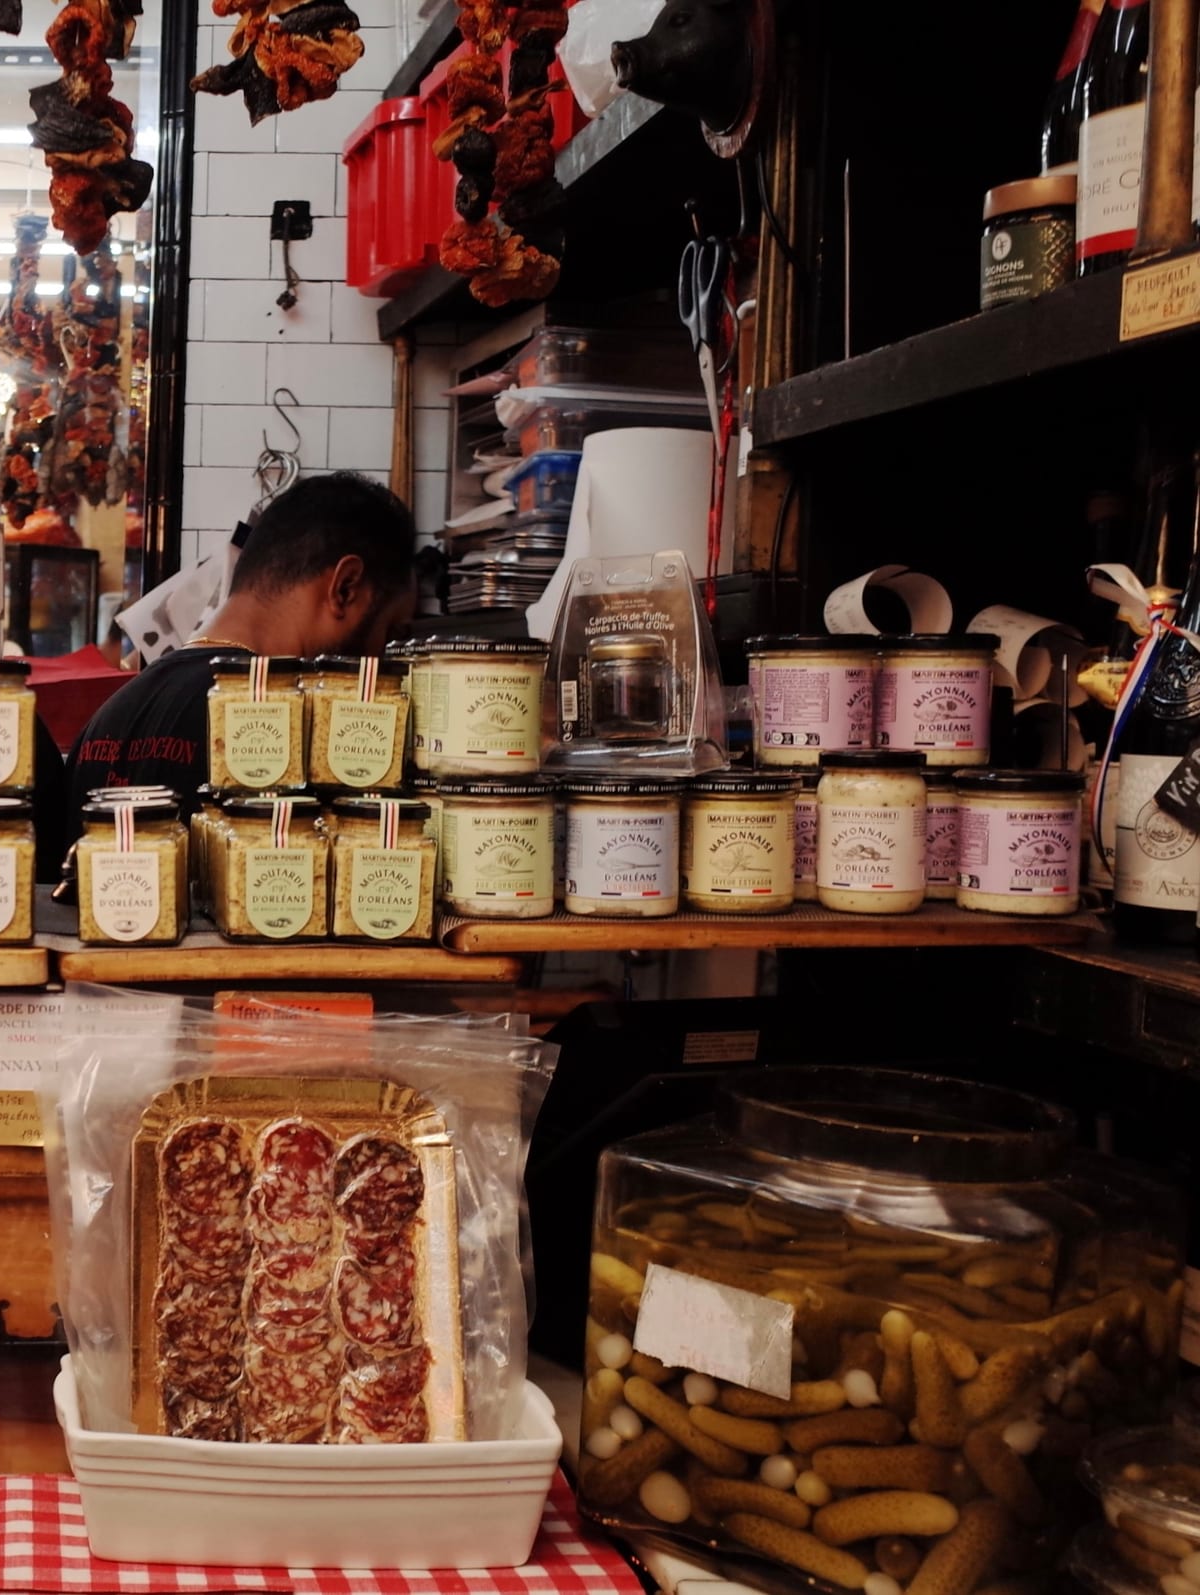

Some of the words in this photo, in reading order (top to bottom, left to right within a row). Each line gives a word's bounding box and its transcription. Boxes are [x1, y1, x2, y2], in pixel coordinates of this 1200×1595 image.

[589, 613, 628, 626] Carpaccio
[467, 692, 528, 716] MAYONNAISE
[913, 686, 976, 708] MAYONNAISE
[232, 721, 282, 740] MOUTARDE
[336, 721, 387, 742] MOUTARDE
[475, 834, 536, 856] MAYONNAISE
[599, 833, 662, 855] MAYONNAISE
[709, 831, 773, 854] MAYONNAISE
[832, 826, 896, 849] MAYONNAISE
[253, 868, 305, 888] MOUTARDE
[360, 869, 412, 891] MOUTARDE
[252, 894, 306, 903] D'ORLÉANS
[358, 894, 413, 905] D'ORLÉANS
